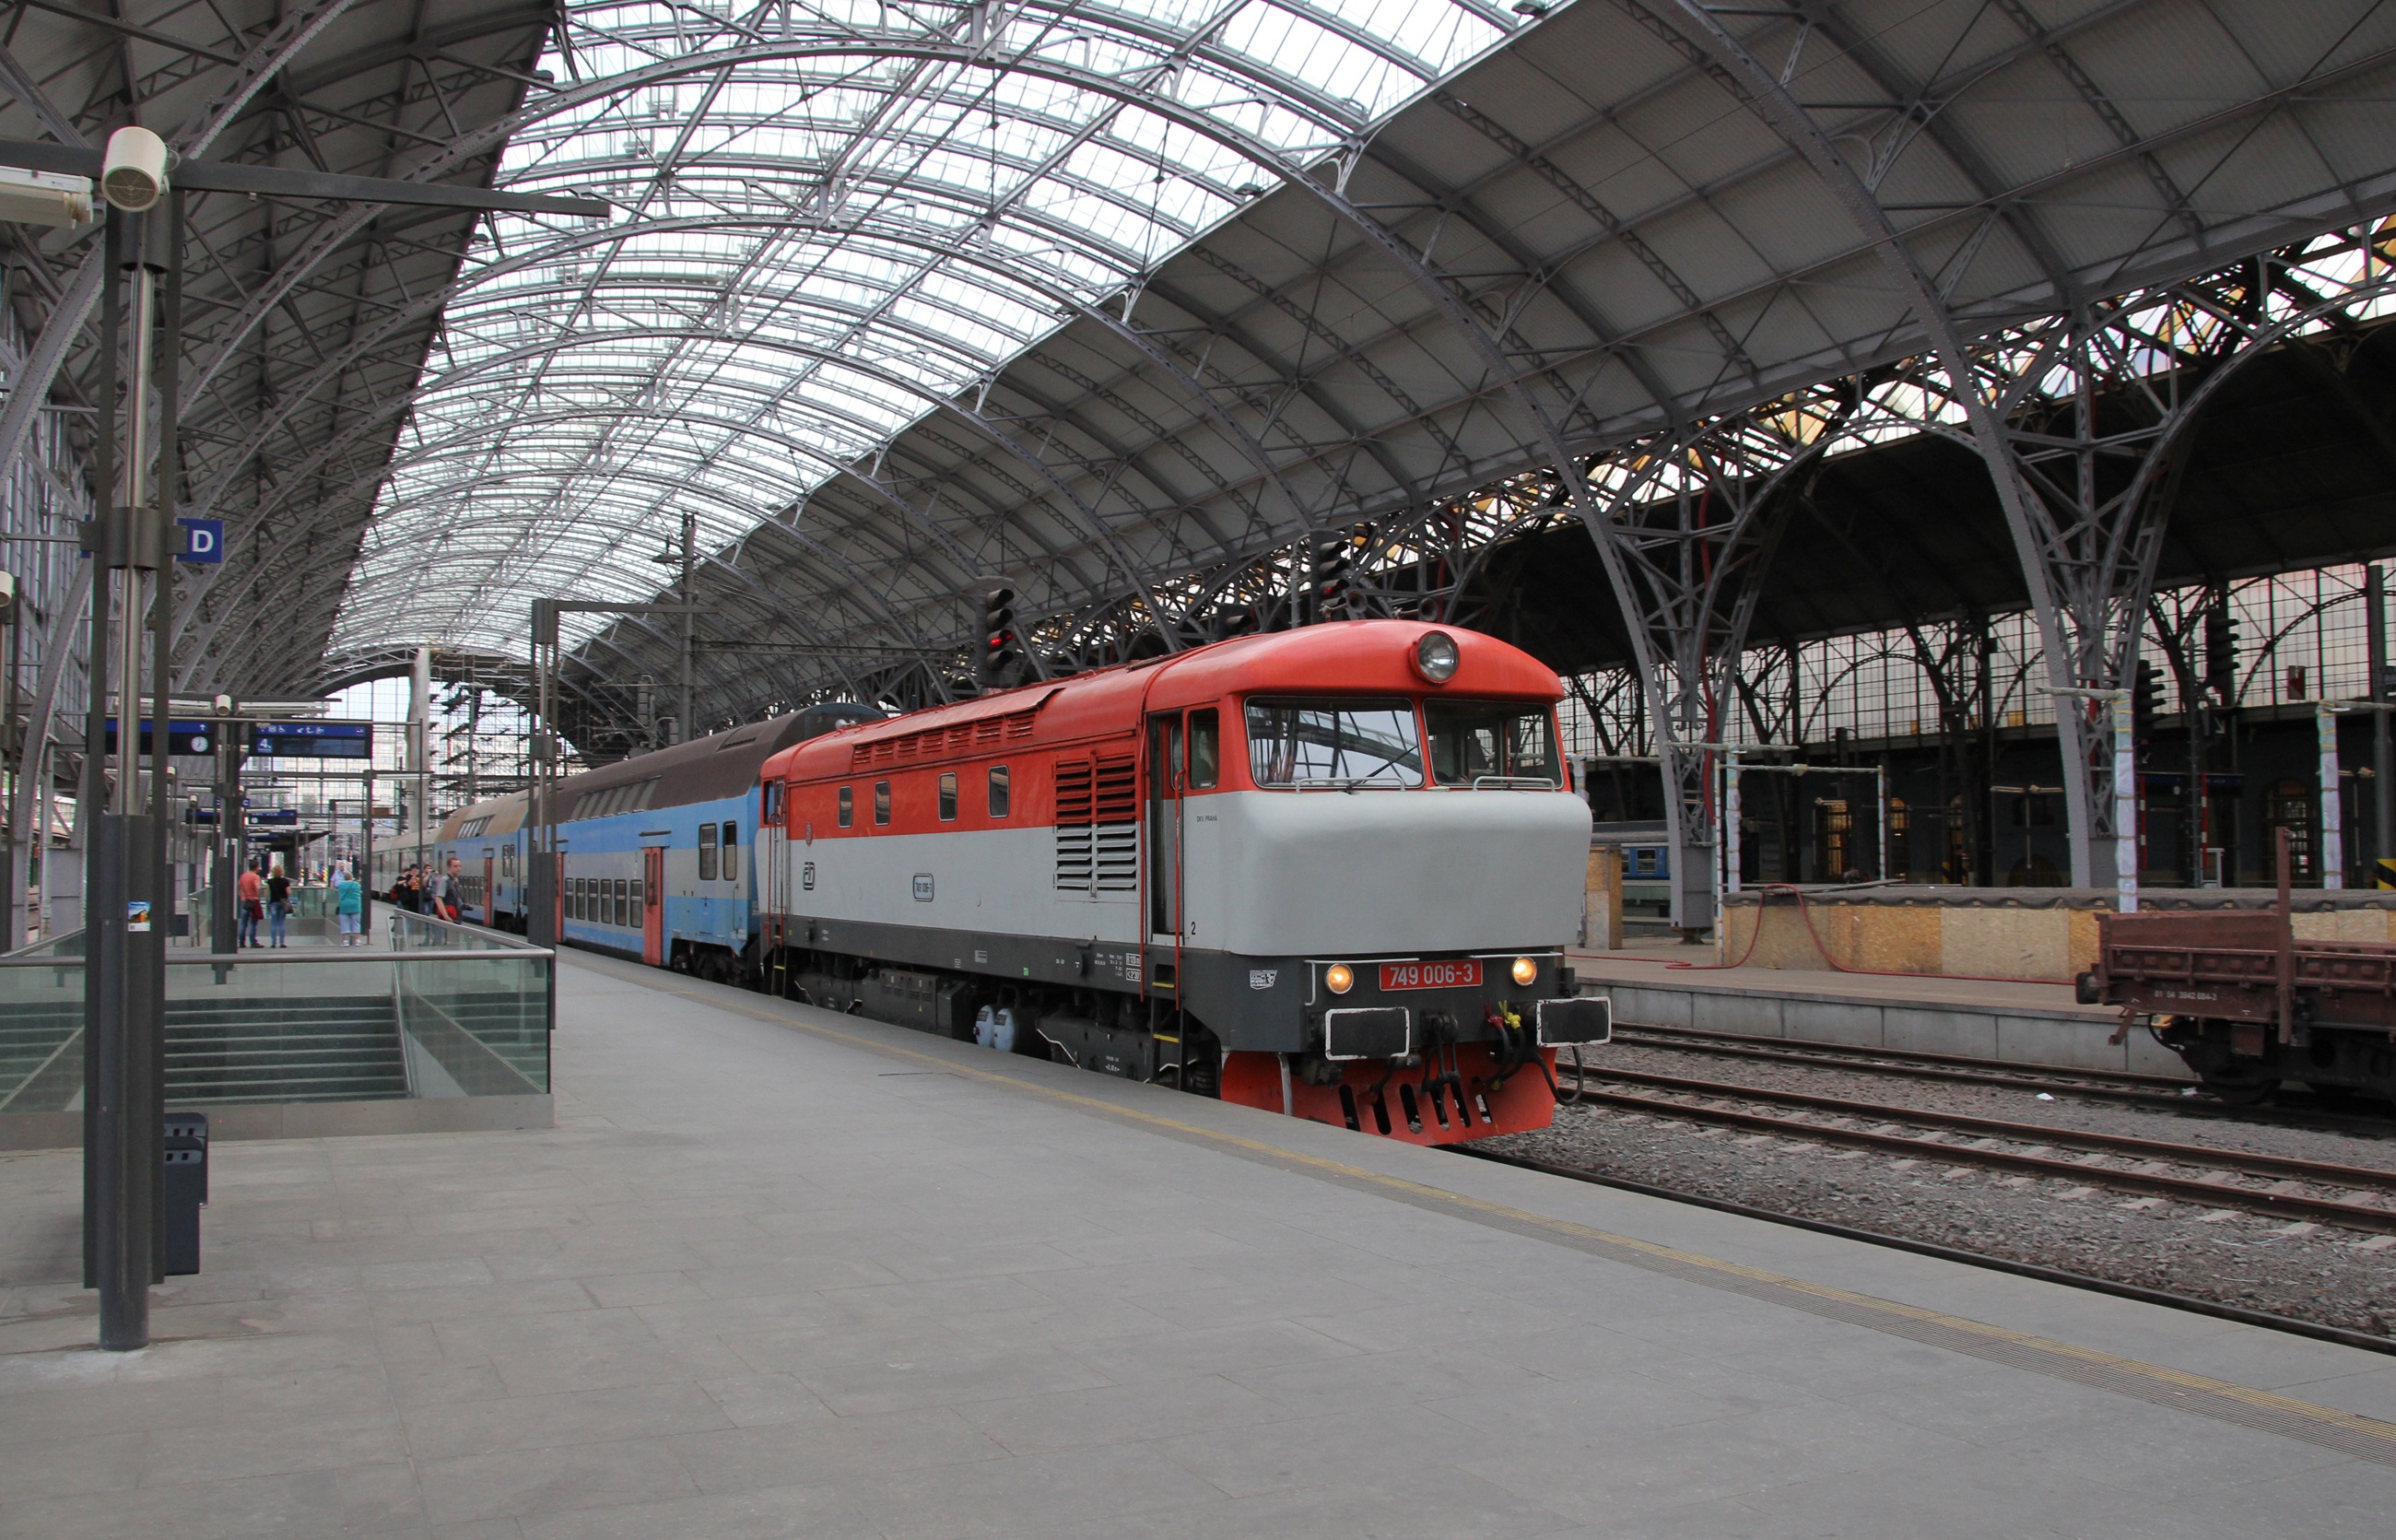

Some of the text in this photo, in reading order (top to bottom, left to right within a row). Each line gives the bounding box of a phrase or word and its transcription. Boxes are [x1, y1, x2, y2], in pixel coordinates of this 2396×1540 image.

[192, 529, 214, 552] D
[1191, 921, 1196, 935] 2
[1390, 963, 1474, 987] 749 006-3
